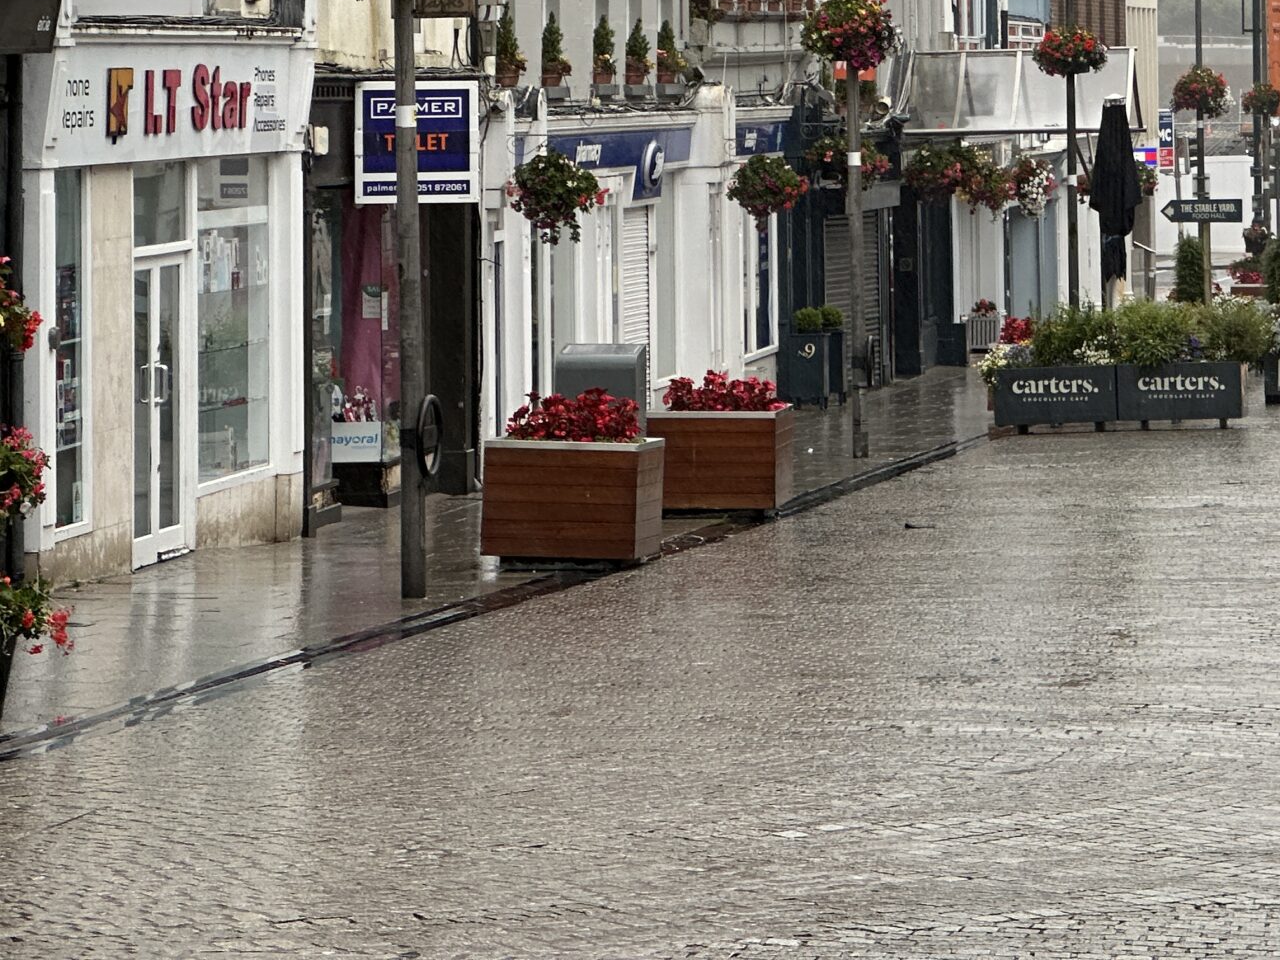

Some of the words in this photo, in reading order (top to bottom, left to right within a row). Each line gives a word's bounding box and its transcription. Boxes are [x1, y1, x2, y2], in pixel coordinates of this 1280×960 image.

[144, 70, 182, 136] LT
[191, 64, 251, 132] Star
[377, 102, 456, 113] PAMER
[415, 133, 449, 151] LET
[434, 183, 467, 191] 872061
[1180, 204, 1193, 213] THE
[1193, 204, 1217, 213] STABLE
[1012, 376, 1099, 394] carters.
[1138, 374, 1226, 391] carters.
